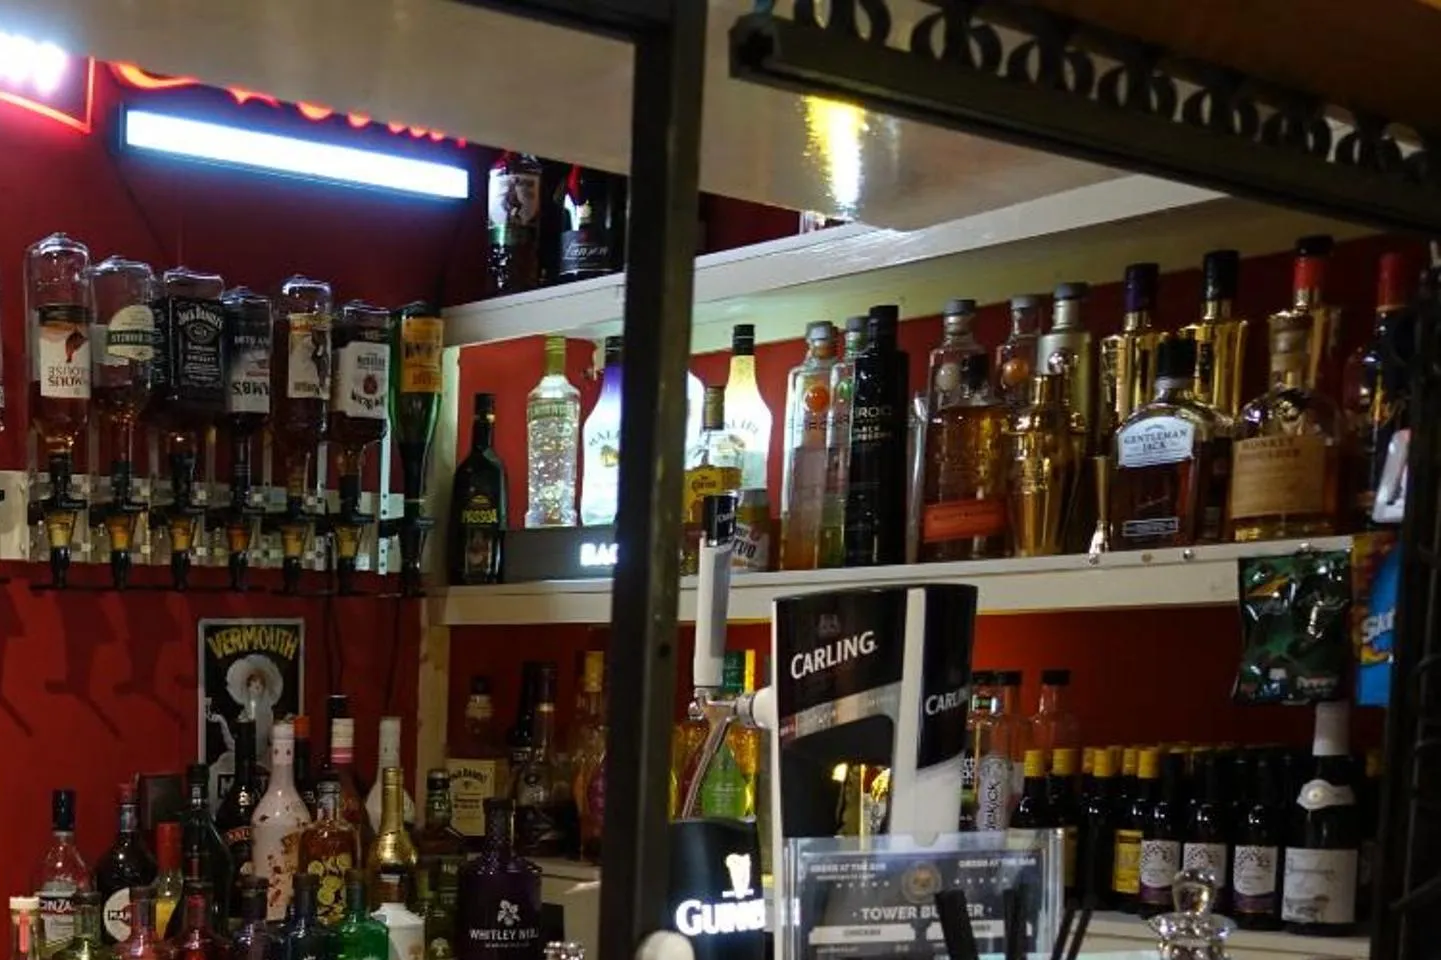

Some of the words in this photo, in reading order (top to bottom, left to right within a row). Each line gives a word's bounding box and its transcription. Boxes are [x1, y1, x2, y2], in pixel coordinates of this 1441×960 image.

[1124, 428, 1188, 445] GENTLEMAN
[1142, 440, 1168, 451] JACK
[207, 624, 301, 660] VERMOUTH
[790, 630, 876, 680] CARLING
[861, 904, 917, 921] TOWER
[920, 903, 985, 920] BUER
[469, 927, 517, 942] WHITLEY
